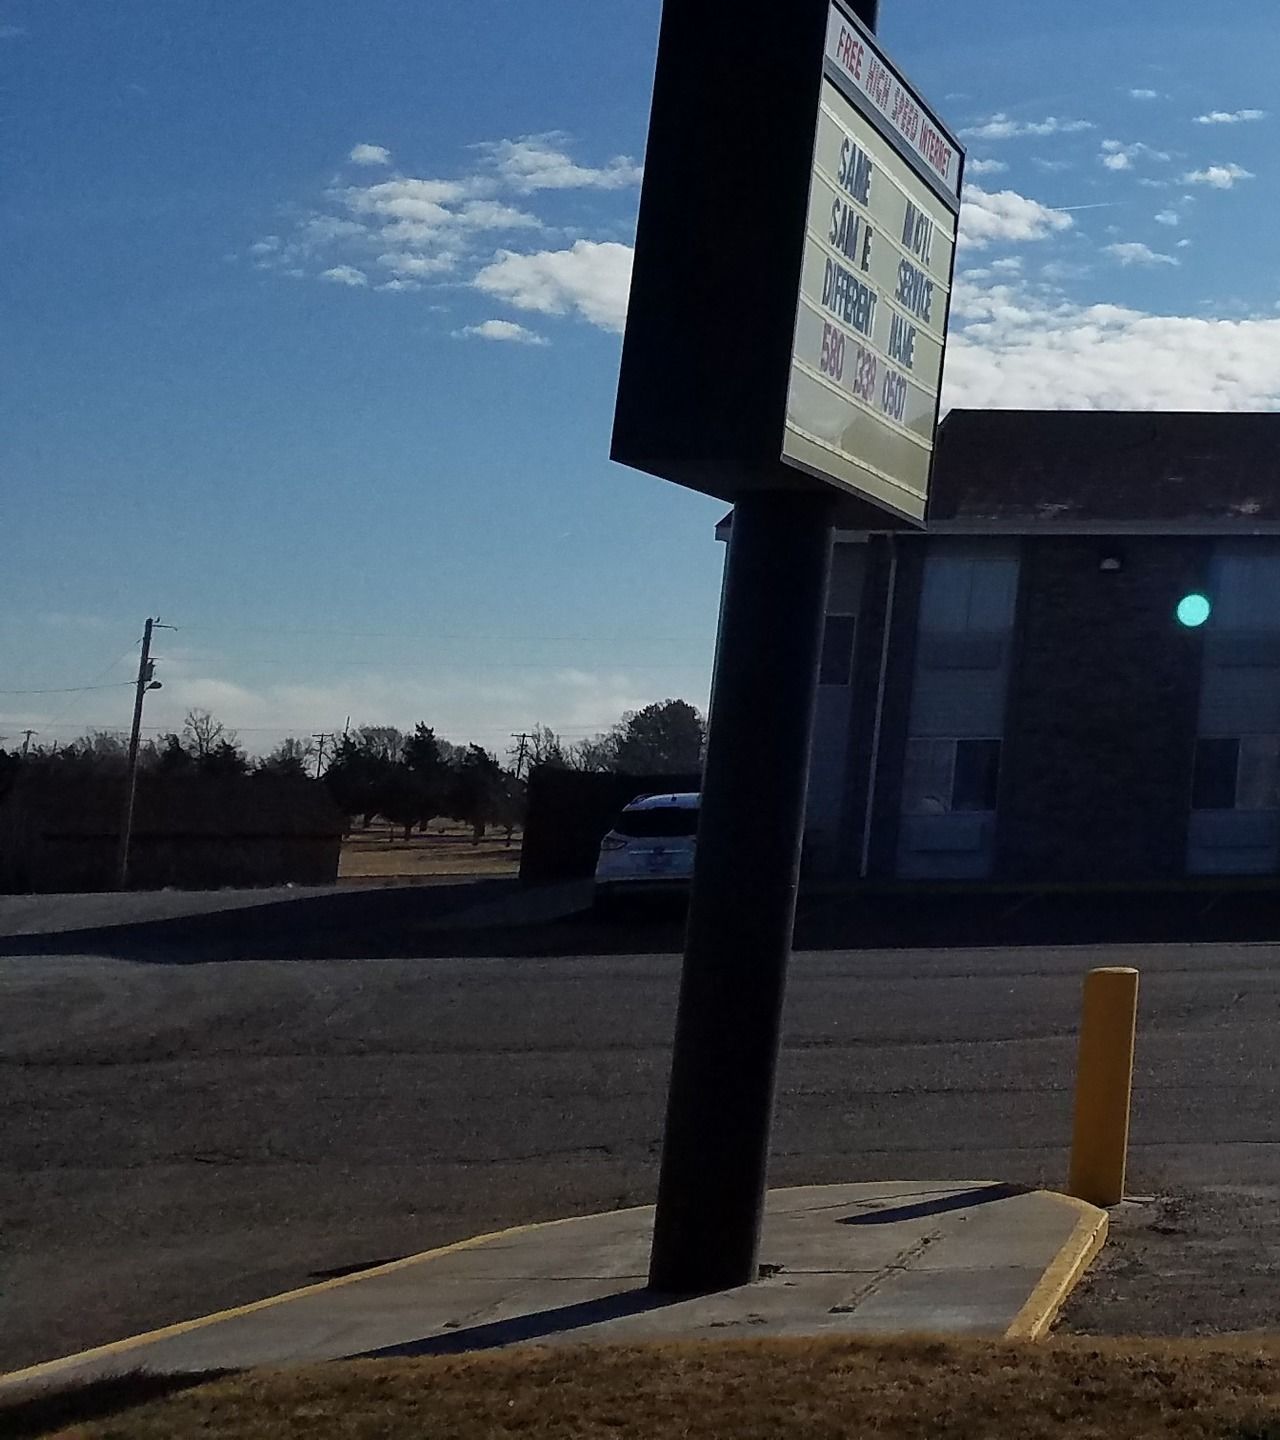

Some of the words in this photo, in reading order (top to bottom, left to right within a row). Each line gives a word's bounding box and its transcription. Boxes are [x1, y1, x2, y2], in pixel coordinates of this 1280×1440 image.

[836, 24, 865, 81] FREE
[865, 57, 893, 111] HIGH
[891, 87, 919, 143] SPEED
[918, 118, 952, 179] INTERNET
[837, 136, 873, 208] SAME
[822, 257, 878, 338] DIFFERENT
[887, 311, 916, 370] NAME
[895, 258, 934, 324] SERVICE
[820, 321, 845, 382] 580
